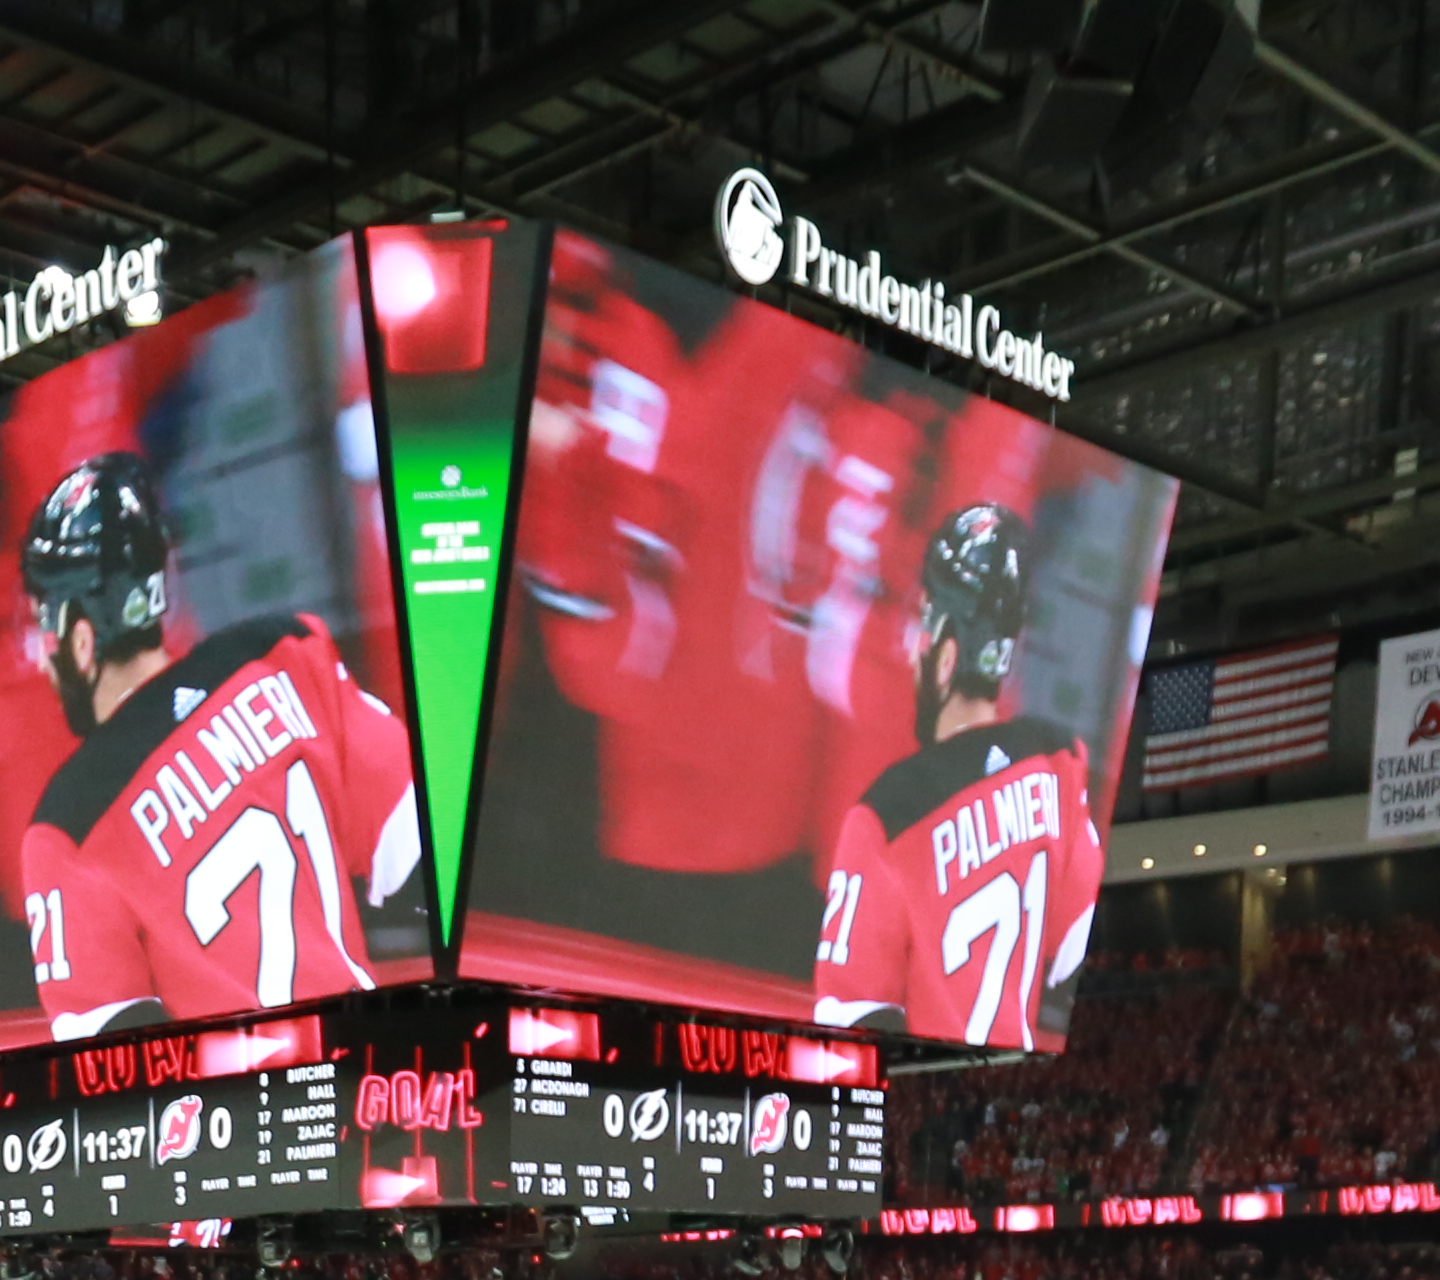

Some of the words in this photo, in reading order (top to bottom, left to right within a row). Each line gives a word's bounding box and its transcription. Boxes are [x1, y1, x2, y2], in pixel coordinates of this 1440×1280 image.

[23, 236, 167, 345] Center
[794, 215, 974, 357] Prudential
[975, 303, 1076, 401] Center
[1405, 648, 1434, 664] NEW
[129, 669, 319, 868] PALMIERI
[931, 772, 1061, 896] PALMIERI
[815, 869, 863, 966] 21
[24, 887, 72, 984] 21
[285, 1063, 336, 1084] BUTCHER
[529, 1059, 573, 1078] GIRARDI
[307, 1083, 336, 1101] HALL
[355, 1066, 483, 1132] GOAL
[529, 1078, 591, 1098] MCDONAGH
[257, 1110, 272, 1126] 17
[281, 1103, 336, 1124] MAROON
[529, 1098, 567, 1117] CIRELLI
[602, 1093, 625, 1139] 0
[683, 1107, 744, 1146] 11:37
[792, 1108, 813, 1151] 0
[2, 1133, 24, 1173] 0
[82, 1125, 148, 1164] 11:37
[208, 1106, 233, 1150] 0
[257, 1129, 272, 1146] 19
[296, 1122, 336, 1142] ZAJAC
[257, 1149, 271, 1165] 21
[285, 1141, 337, 1162] PALMIERI
[174, 1185, 188, 1207] 3
[515, 1175, 534, 1195] 17
[540, 1176, 568, 1197] 1:24
[583, 1178, 600, 1198] 13
[605, 1180, 632, 1200] 1:50
[41, 1198, 55, 1218] 4
